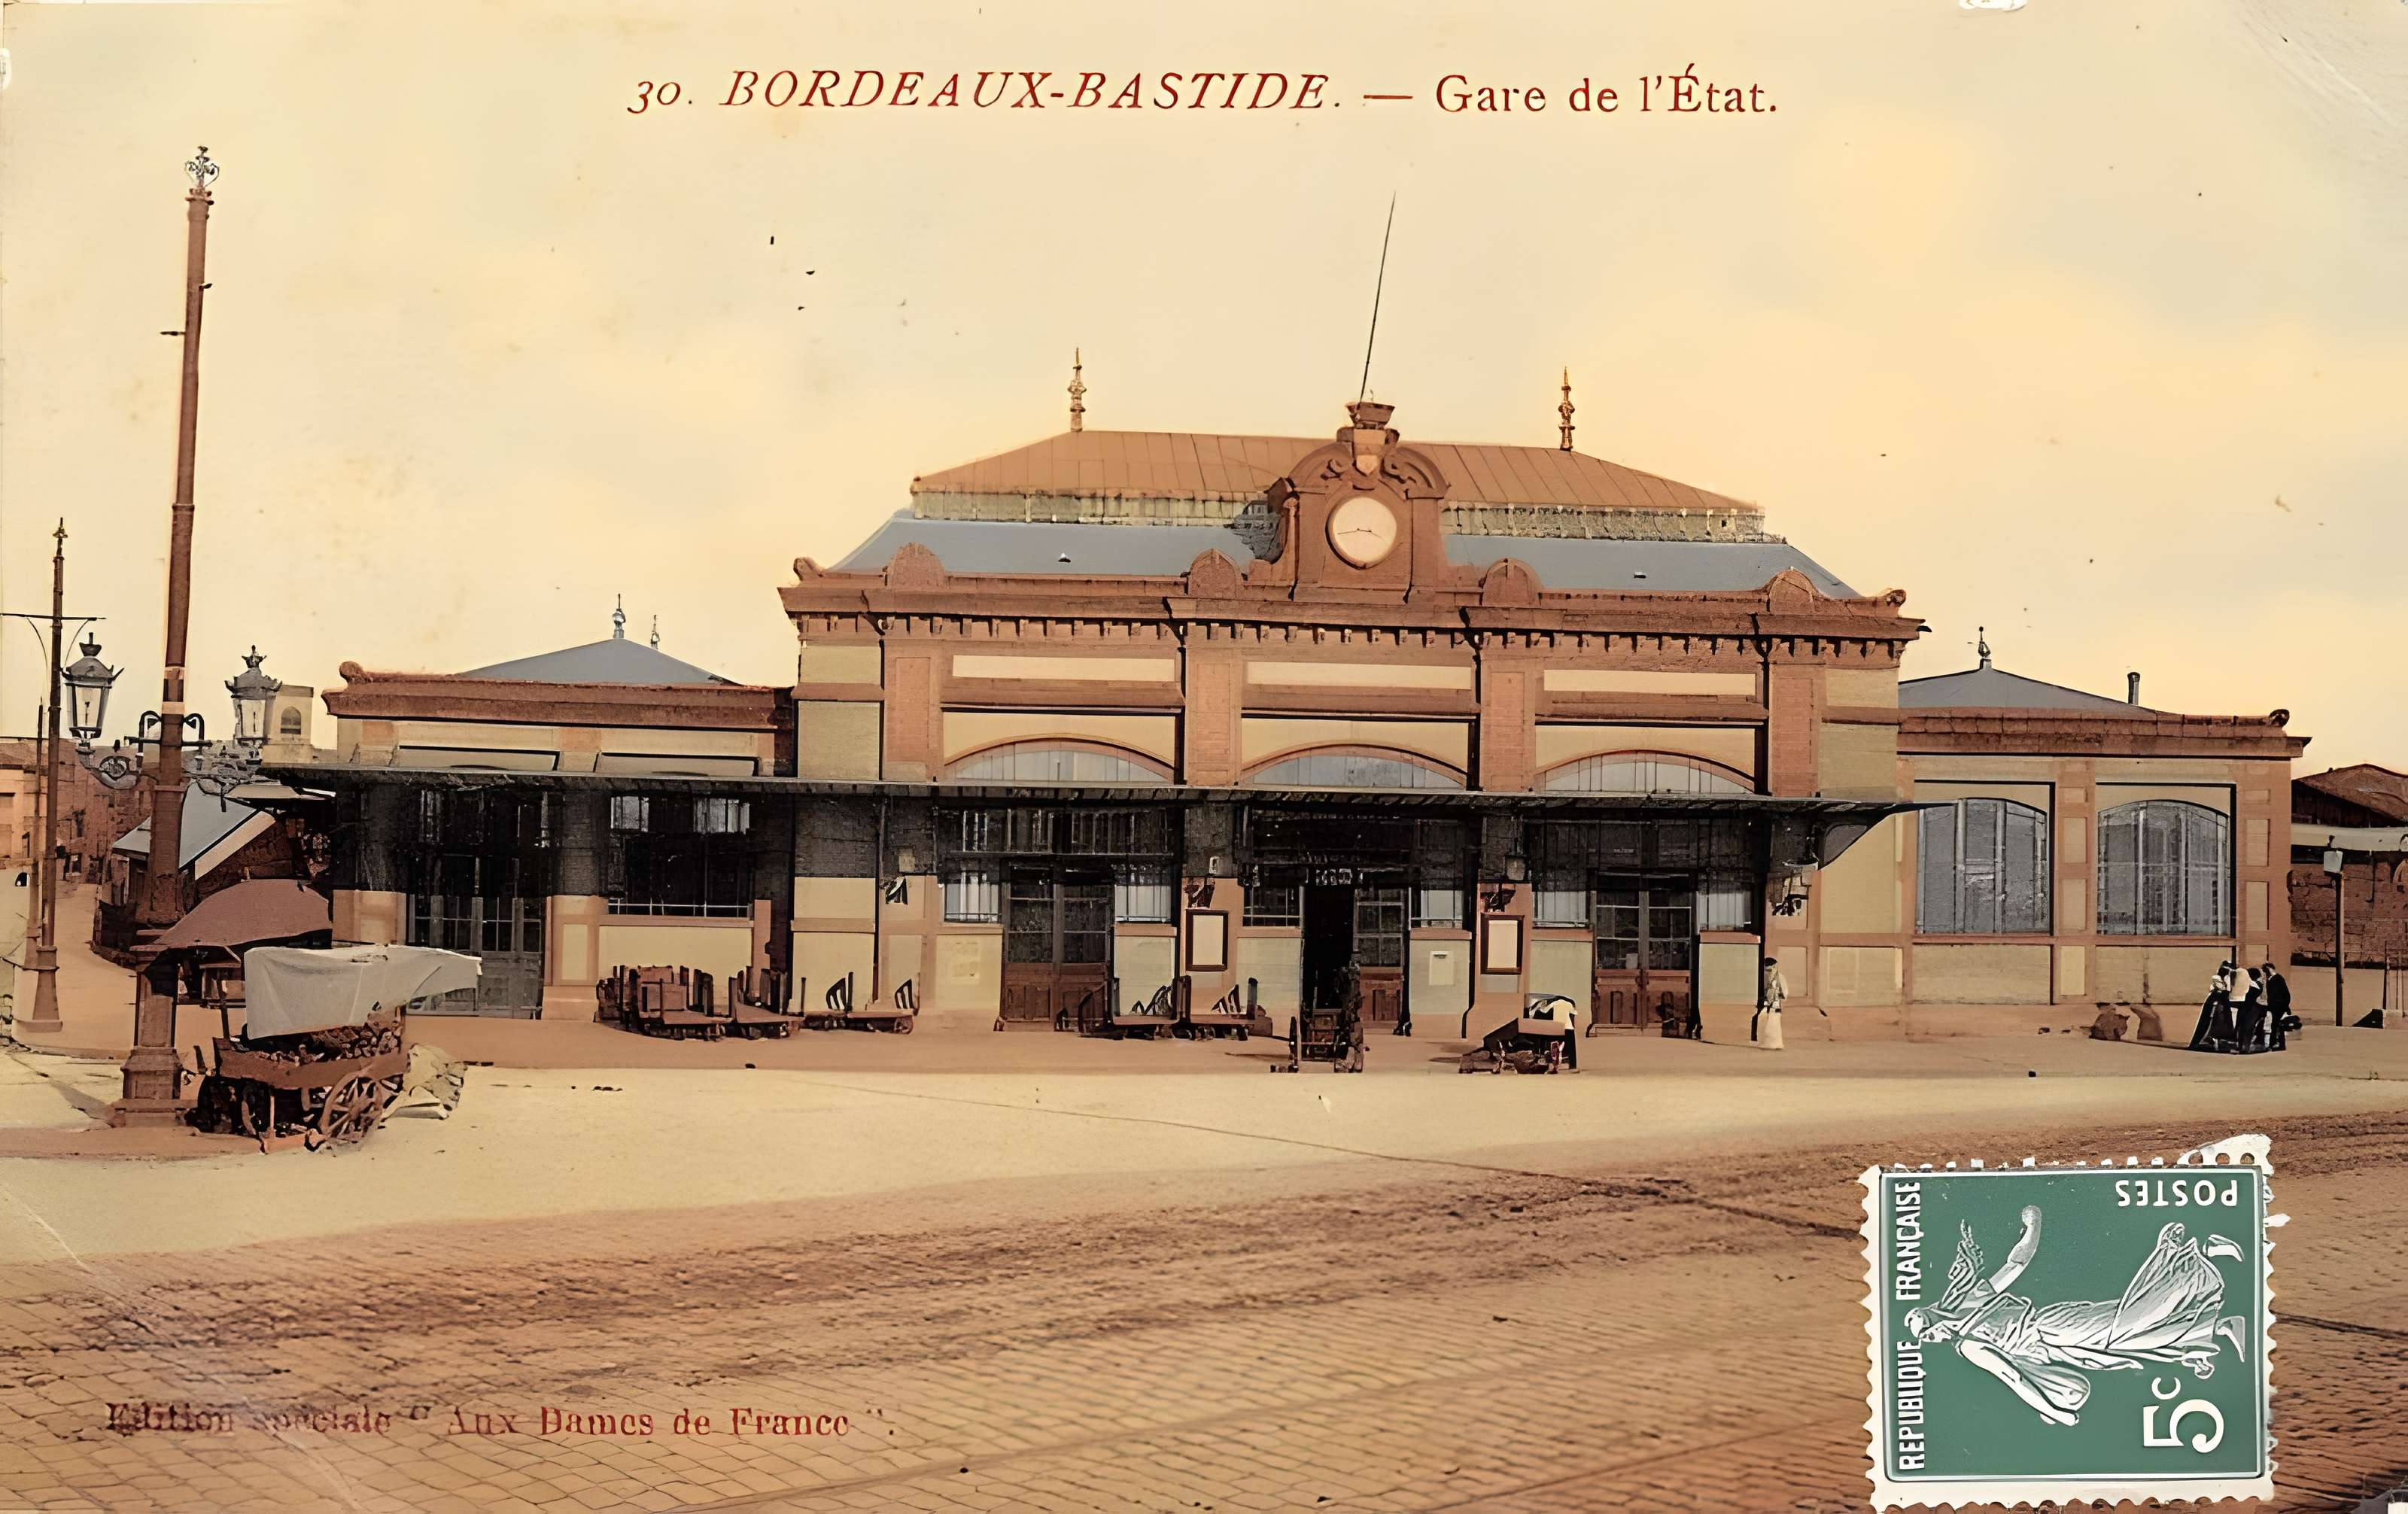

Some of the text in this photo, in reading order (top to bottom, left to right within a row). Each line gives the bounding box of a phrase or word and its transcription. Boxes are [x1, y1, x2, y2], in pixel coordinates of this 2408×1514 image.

[2115, 1179, 2238, 1207] POSTES
[1894, 1181, 1926, 1470] REPUBLIQUE FRANÇAISE
